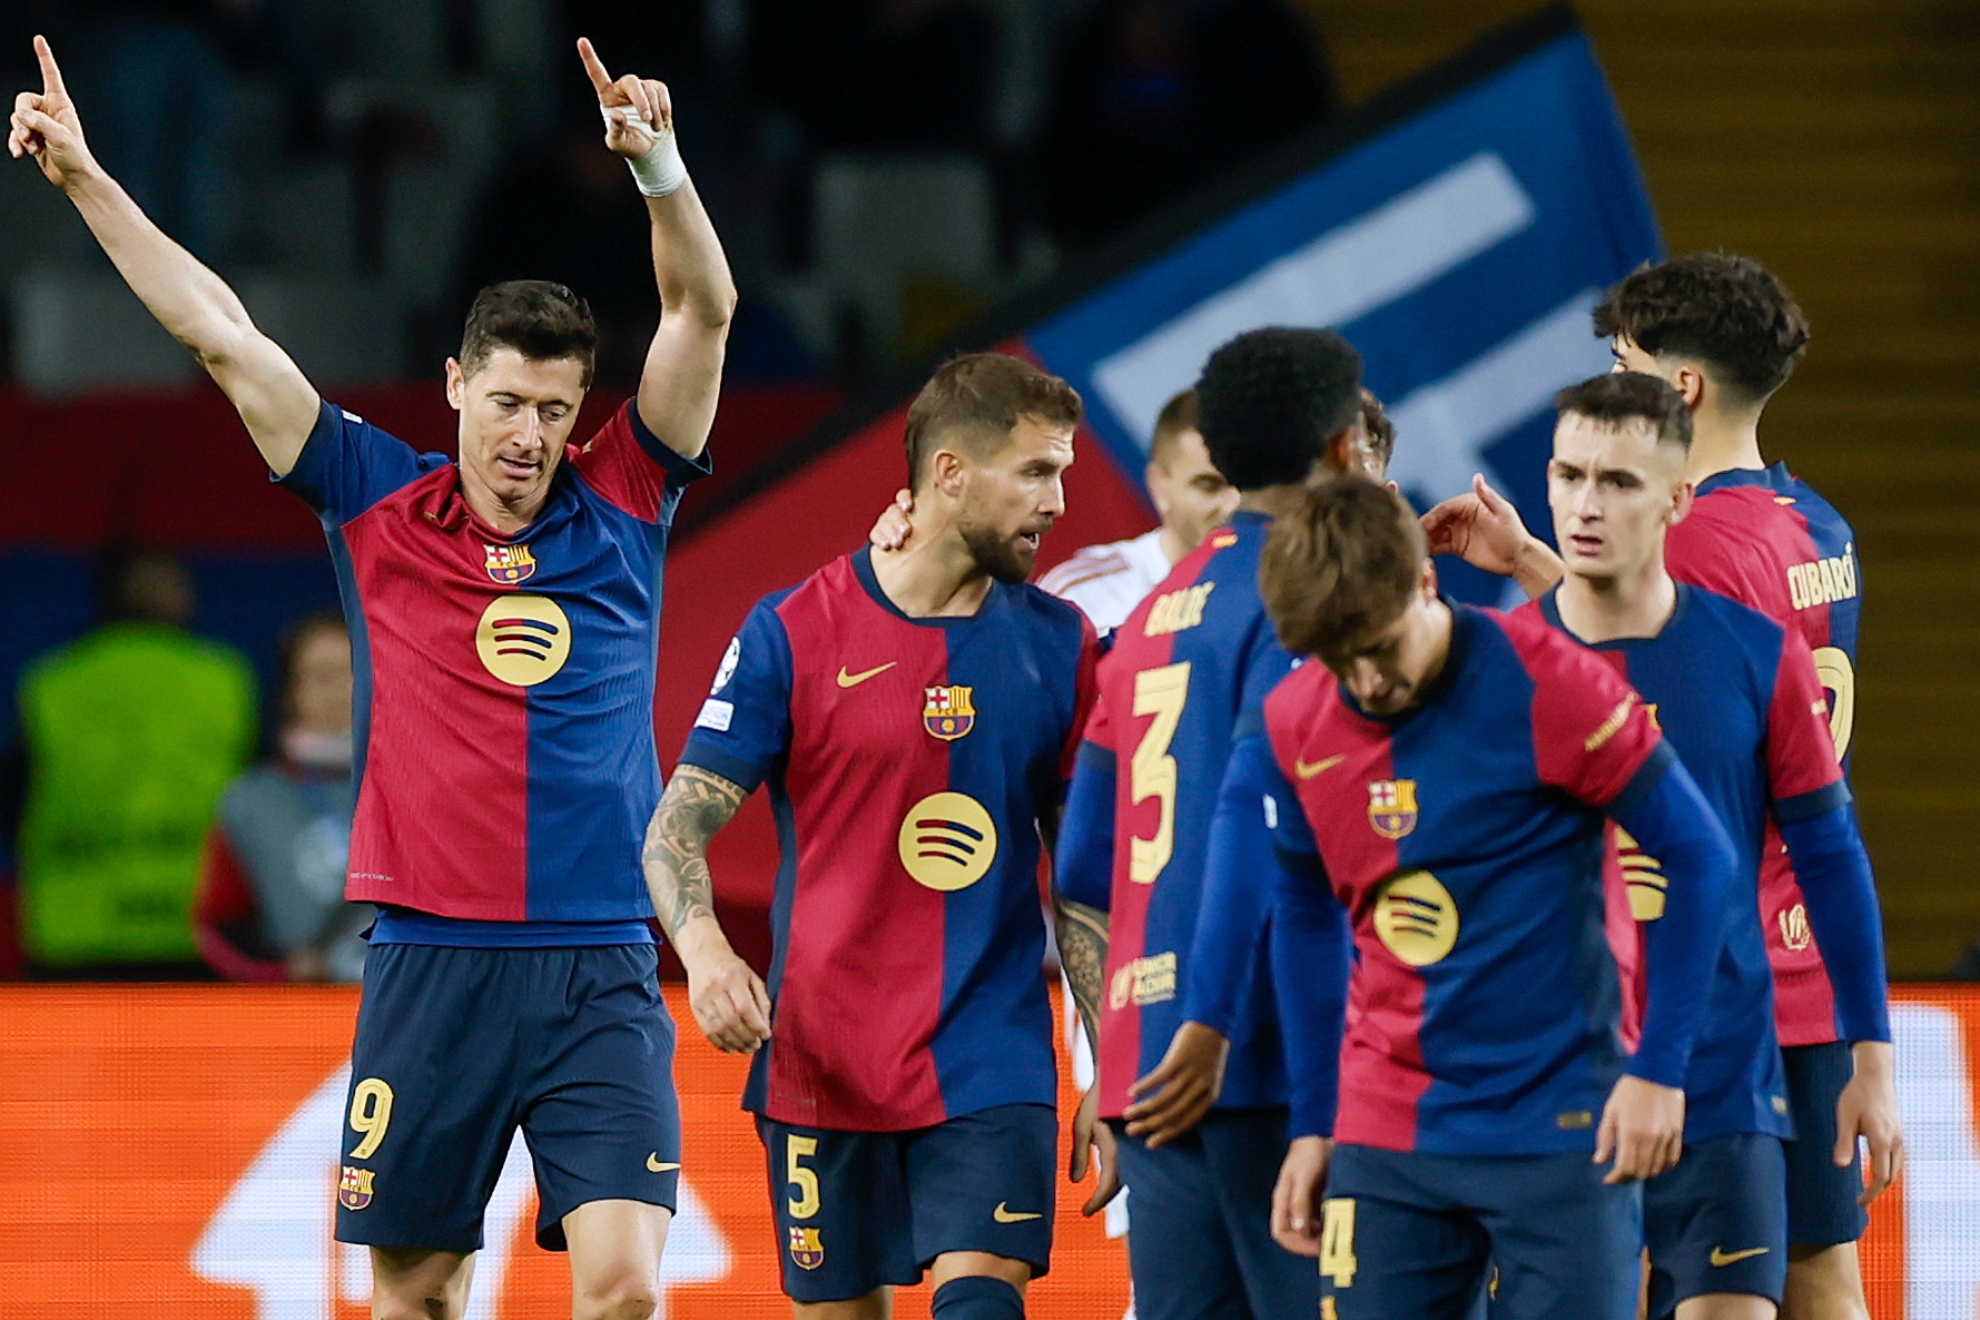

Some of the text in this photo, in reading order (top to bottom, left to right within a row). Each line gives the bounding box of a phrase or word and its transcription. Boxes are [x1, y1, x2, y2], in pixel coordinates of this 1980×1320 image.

[1787, 541, 1857, 611] CUBARSÍ
[1129, 659, 1192, 885] 3
[349, 1077, 394, 1160] 9
[788, 1133, 820, 1219] 5
